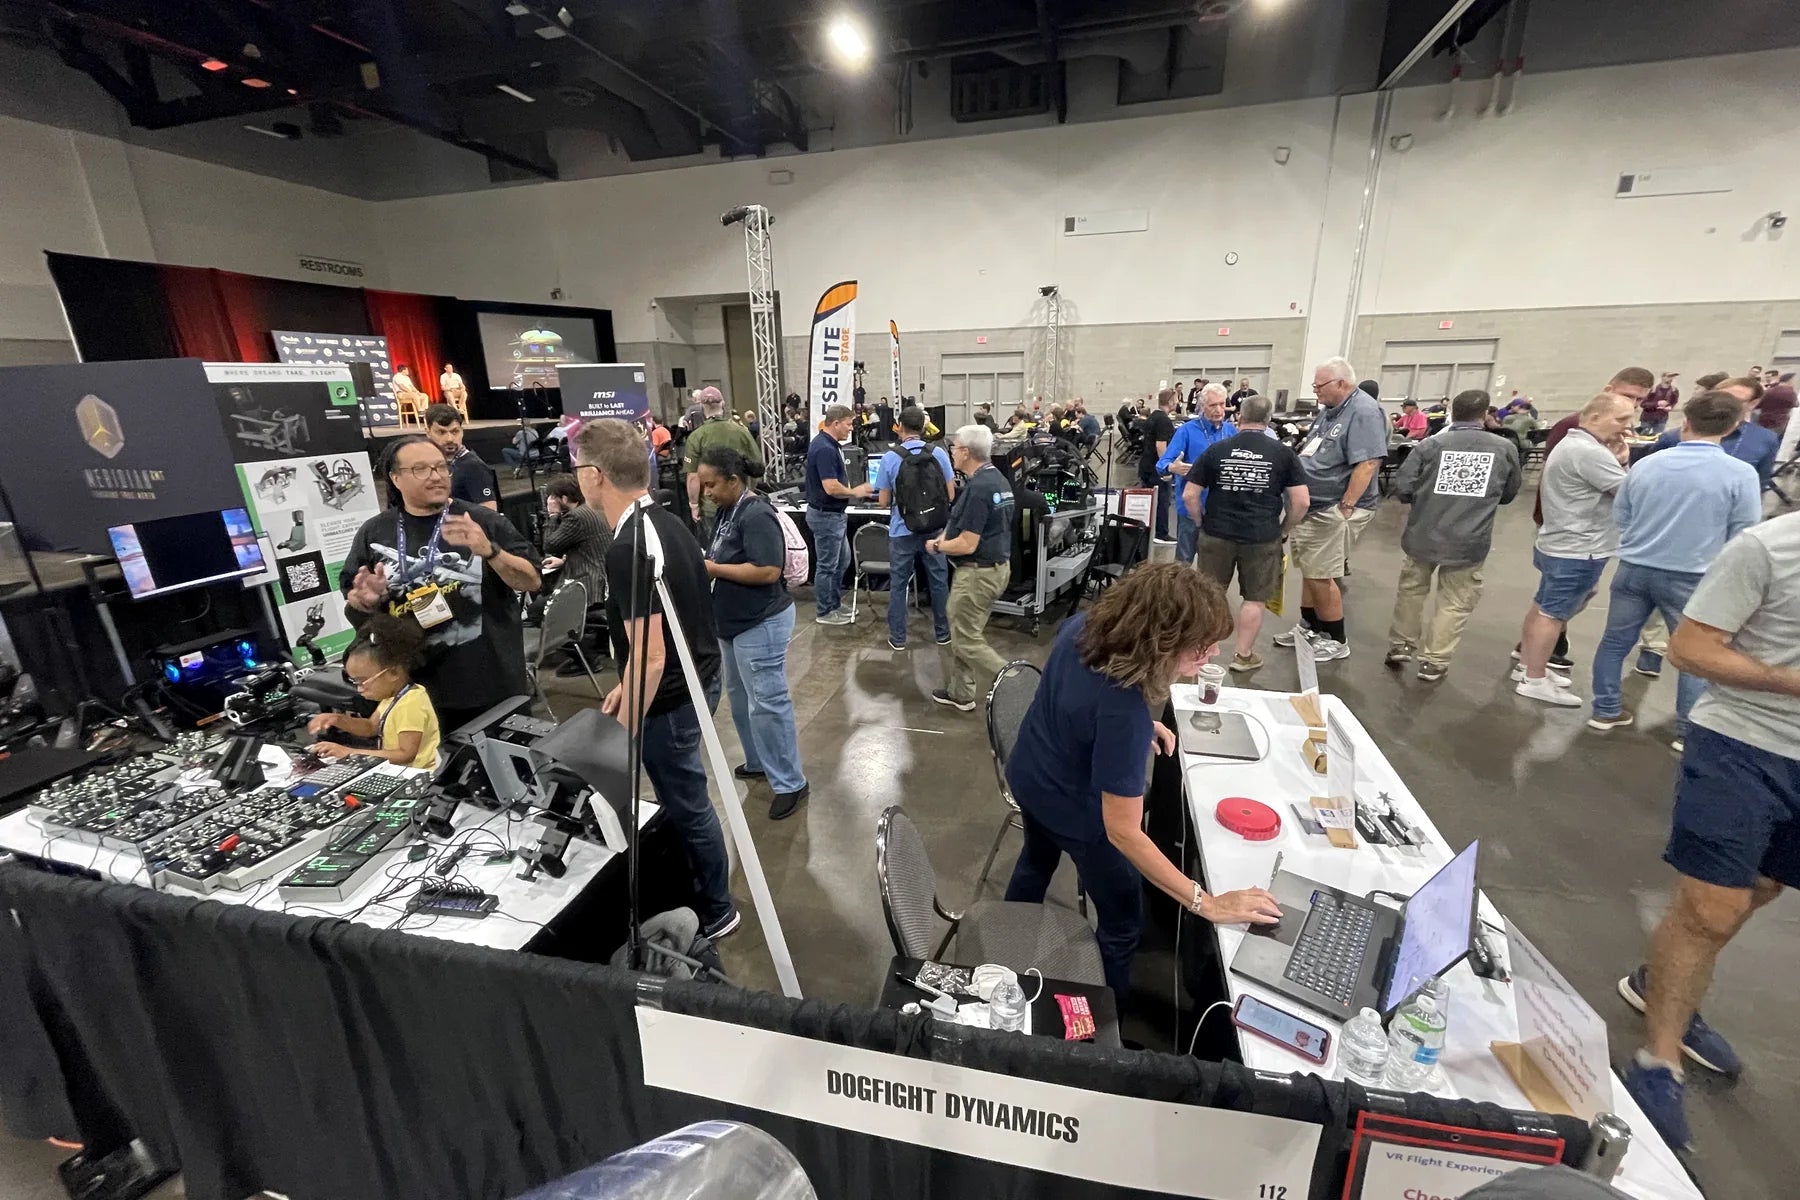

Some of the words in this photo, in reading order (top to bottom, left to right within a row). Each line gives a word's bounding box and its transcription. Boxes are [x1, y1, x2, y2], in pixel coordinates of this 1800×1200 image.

[300, 259, 364, 277] RESTROOMS
[840, 327, 850, 363] STAGE
[593, 391, 616, 399] msi
[827, 1069, 937, 1114] DOGFIGHT
[945, 1092, 1080, 1144] DYNAMICS
[1386, 1152, 1403, 1160] VR
[1407, 1155, 1442, 1166] Flight
[1446, 1160, 1505, 1176] Experien
[1259, 1184, 1287, 1200] 112
